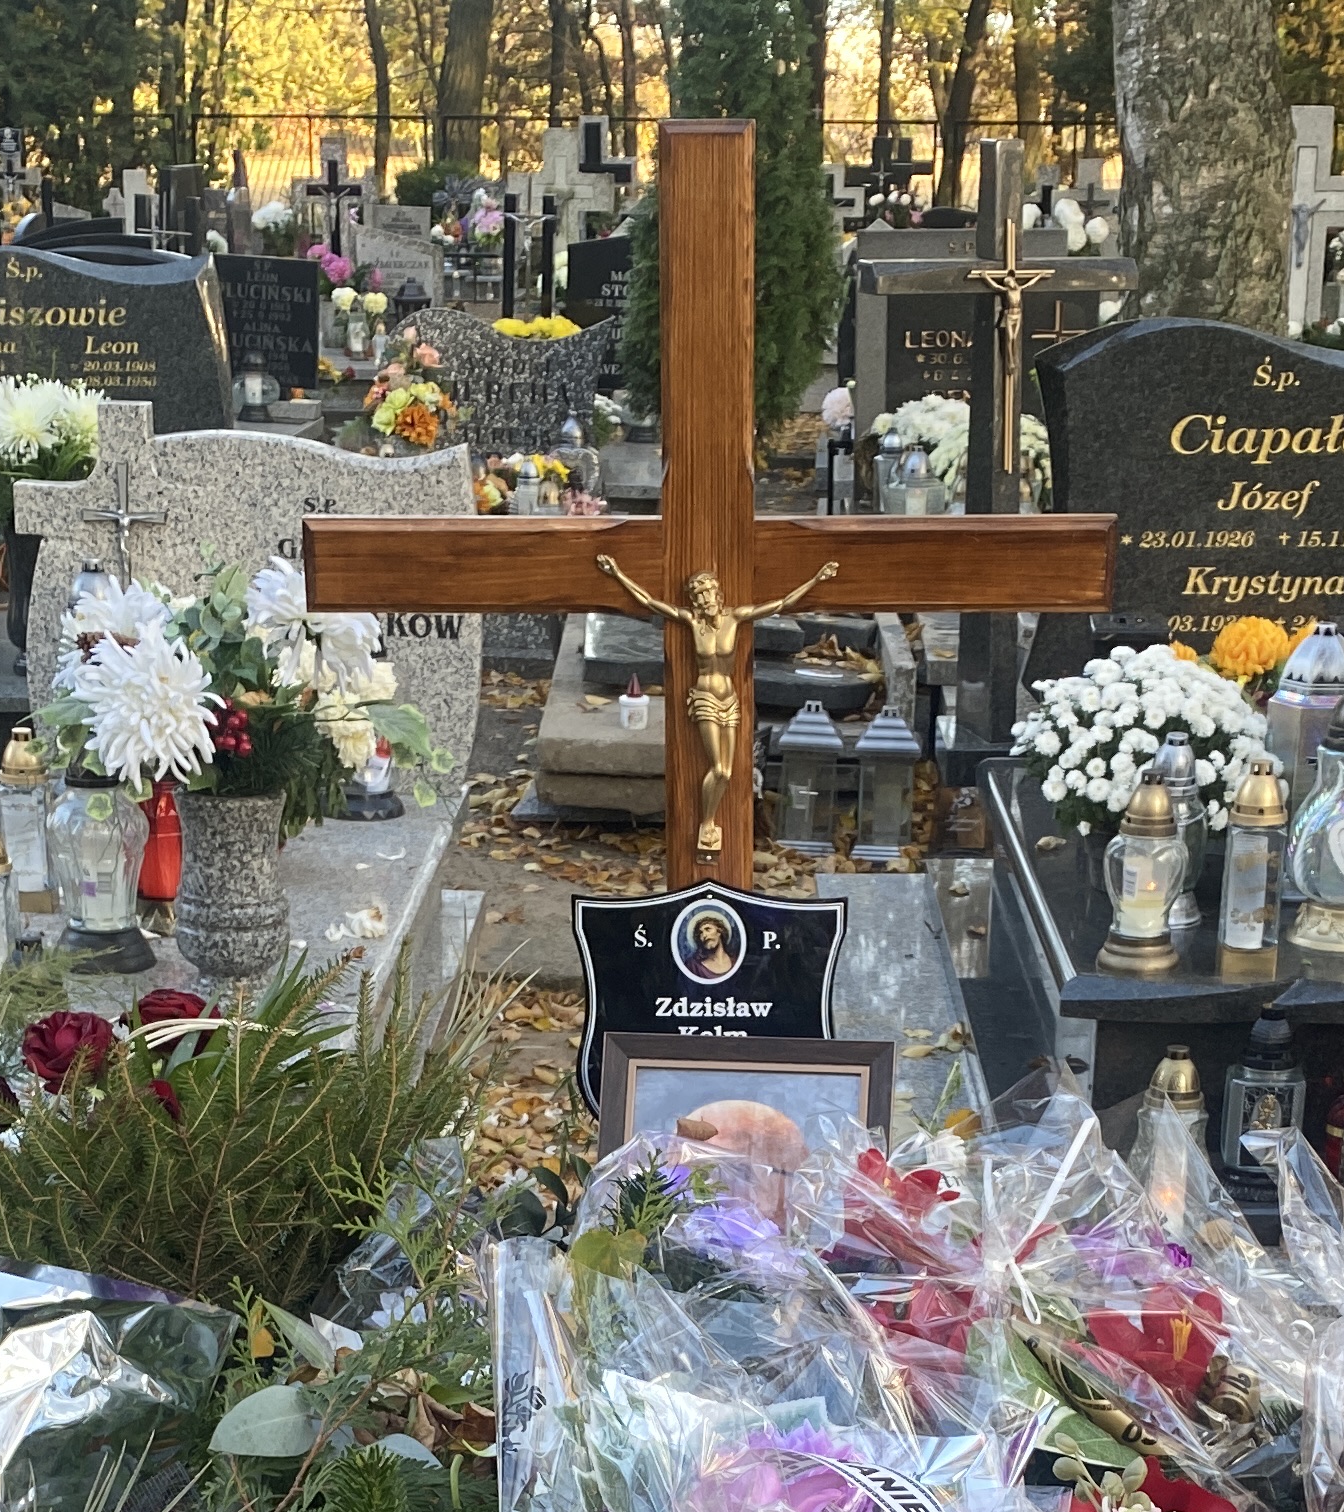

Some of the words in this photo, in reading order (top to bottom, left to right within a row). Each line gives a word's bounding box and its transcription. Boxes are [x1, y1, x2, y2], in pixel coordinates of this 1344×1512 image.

[84, 335, 139, 355] Leon
[231, 333, 313, 353] UCIŃSKA
[1253, 355, 1301, 391] Ś.p.
[1217, 480, 1321, 519] Józef
[1139, 530, 1255, 548] 23.01.1926
[634, 924, 653, 948] Ś.
[763, 931, 781, 950] P.
[655, 996, 773, 1018] Zdzisław
